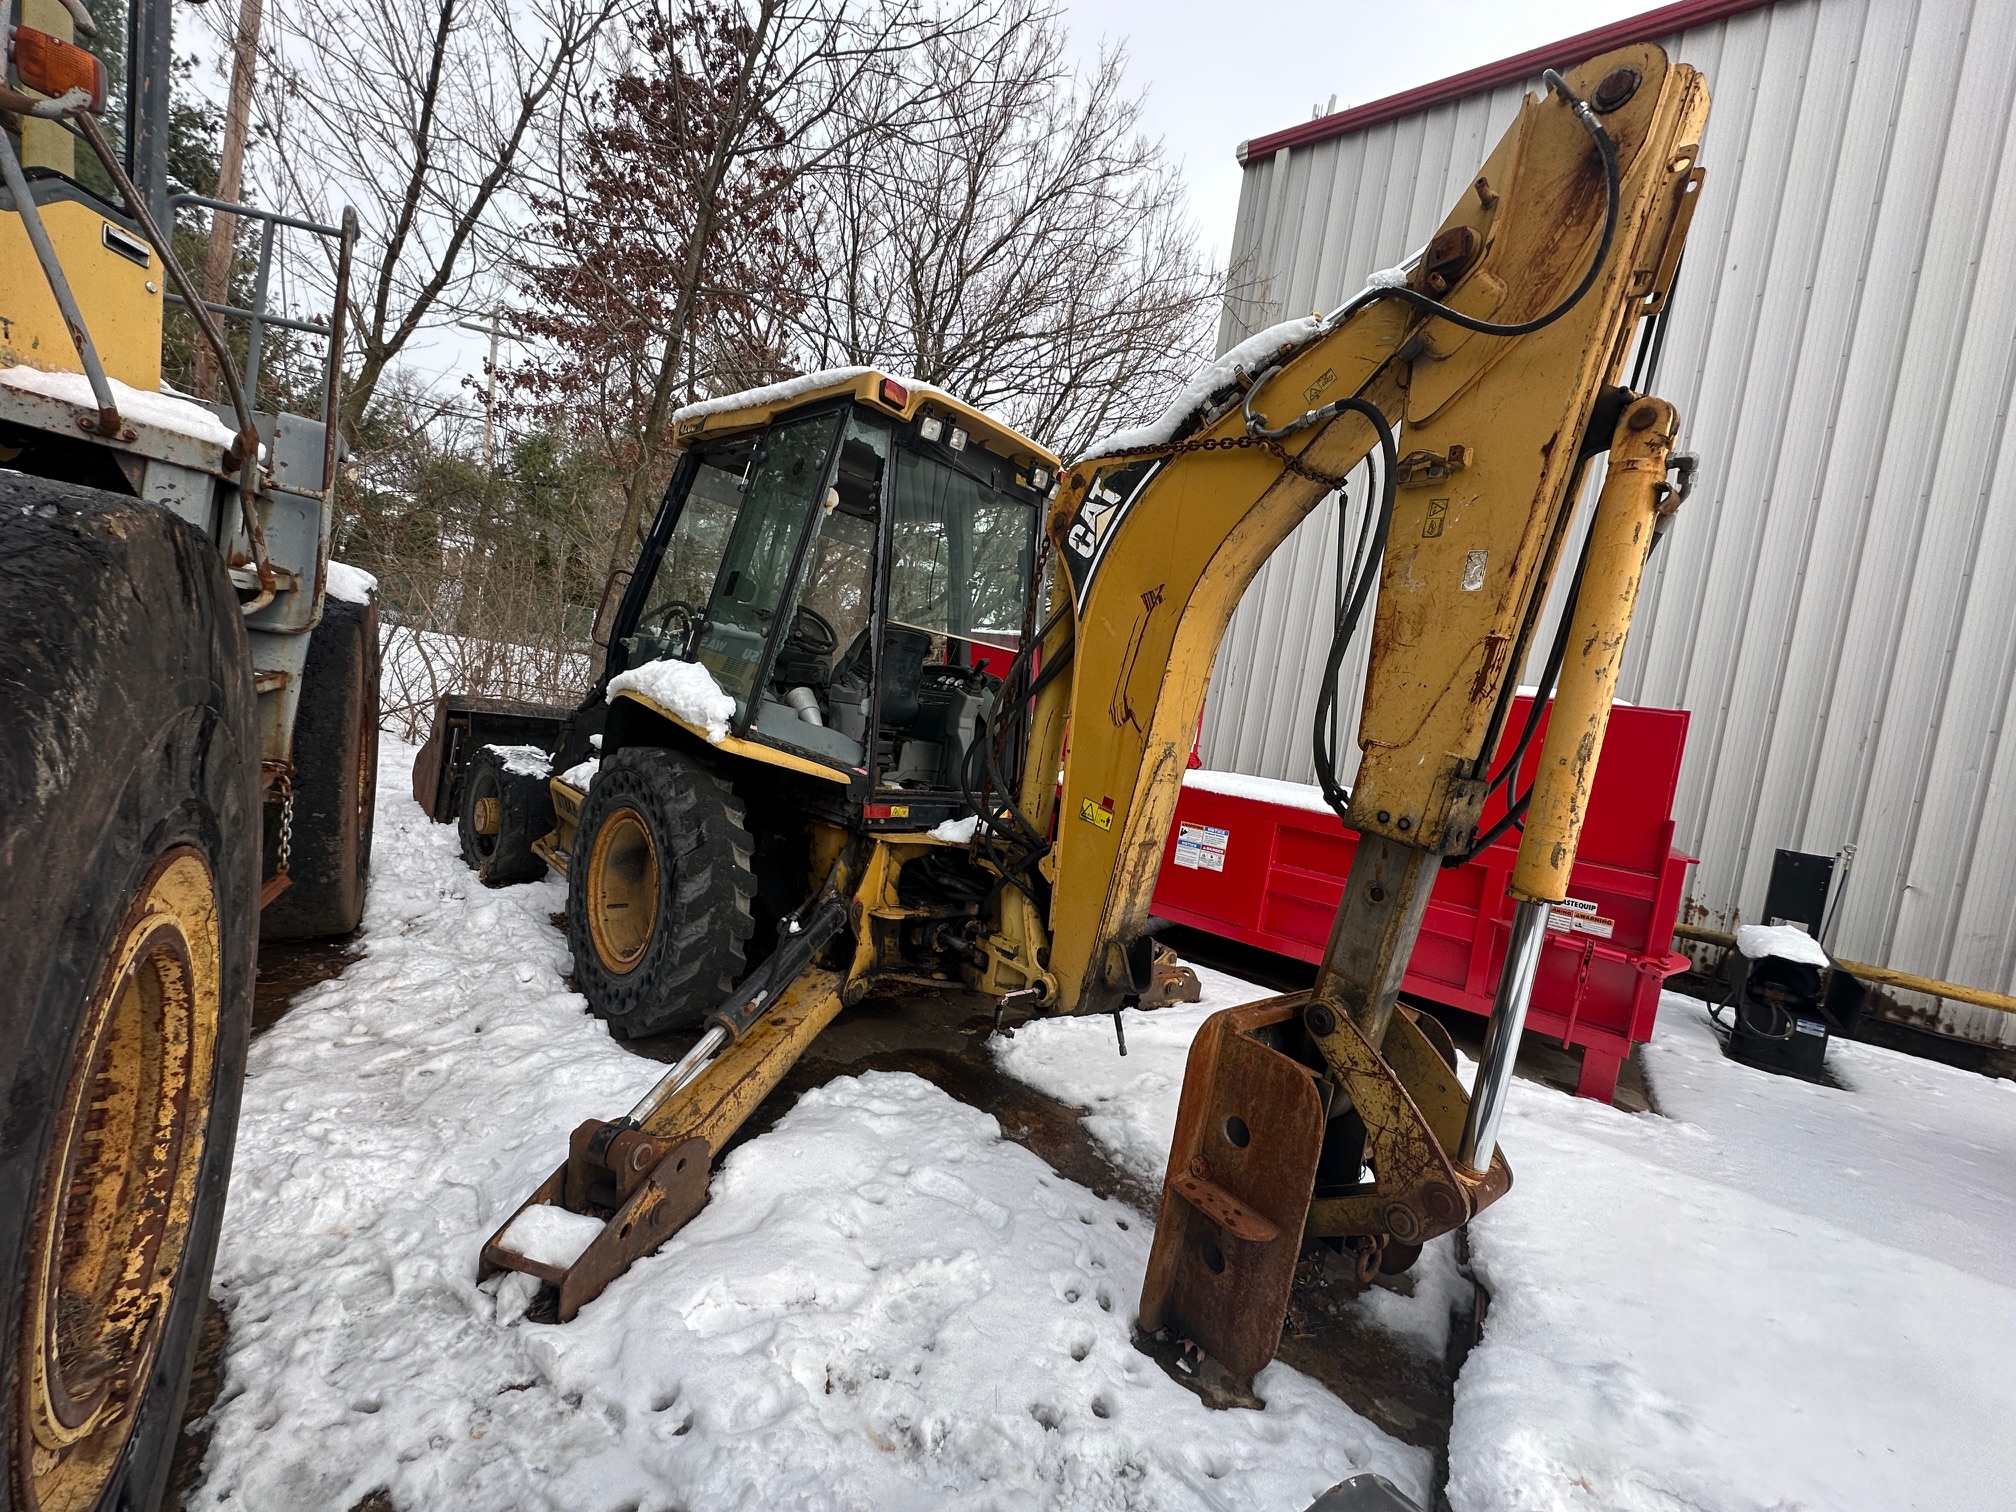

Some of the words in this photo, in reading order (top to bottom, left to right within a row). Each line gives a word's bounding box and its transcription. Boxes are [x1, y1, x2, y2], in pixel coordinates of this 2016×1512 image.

[1068, 476, 1122, 558] CAT
[1563, 899, 1597, 911] ASTEQUIP
[1580, 913, 1613, 926] WARNING
